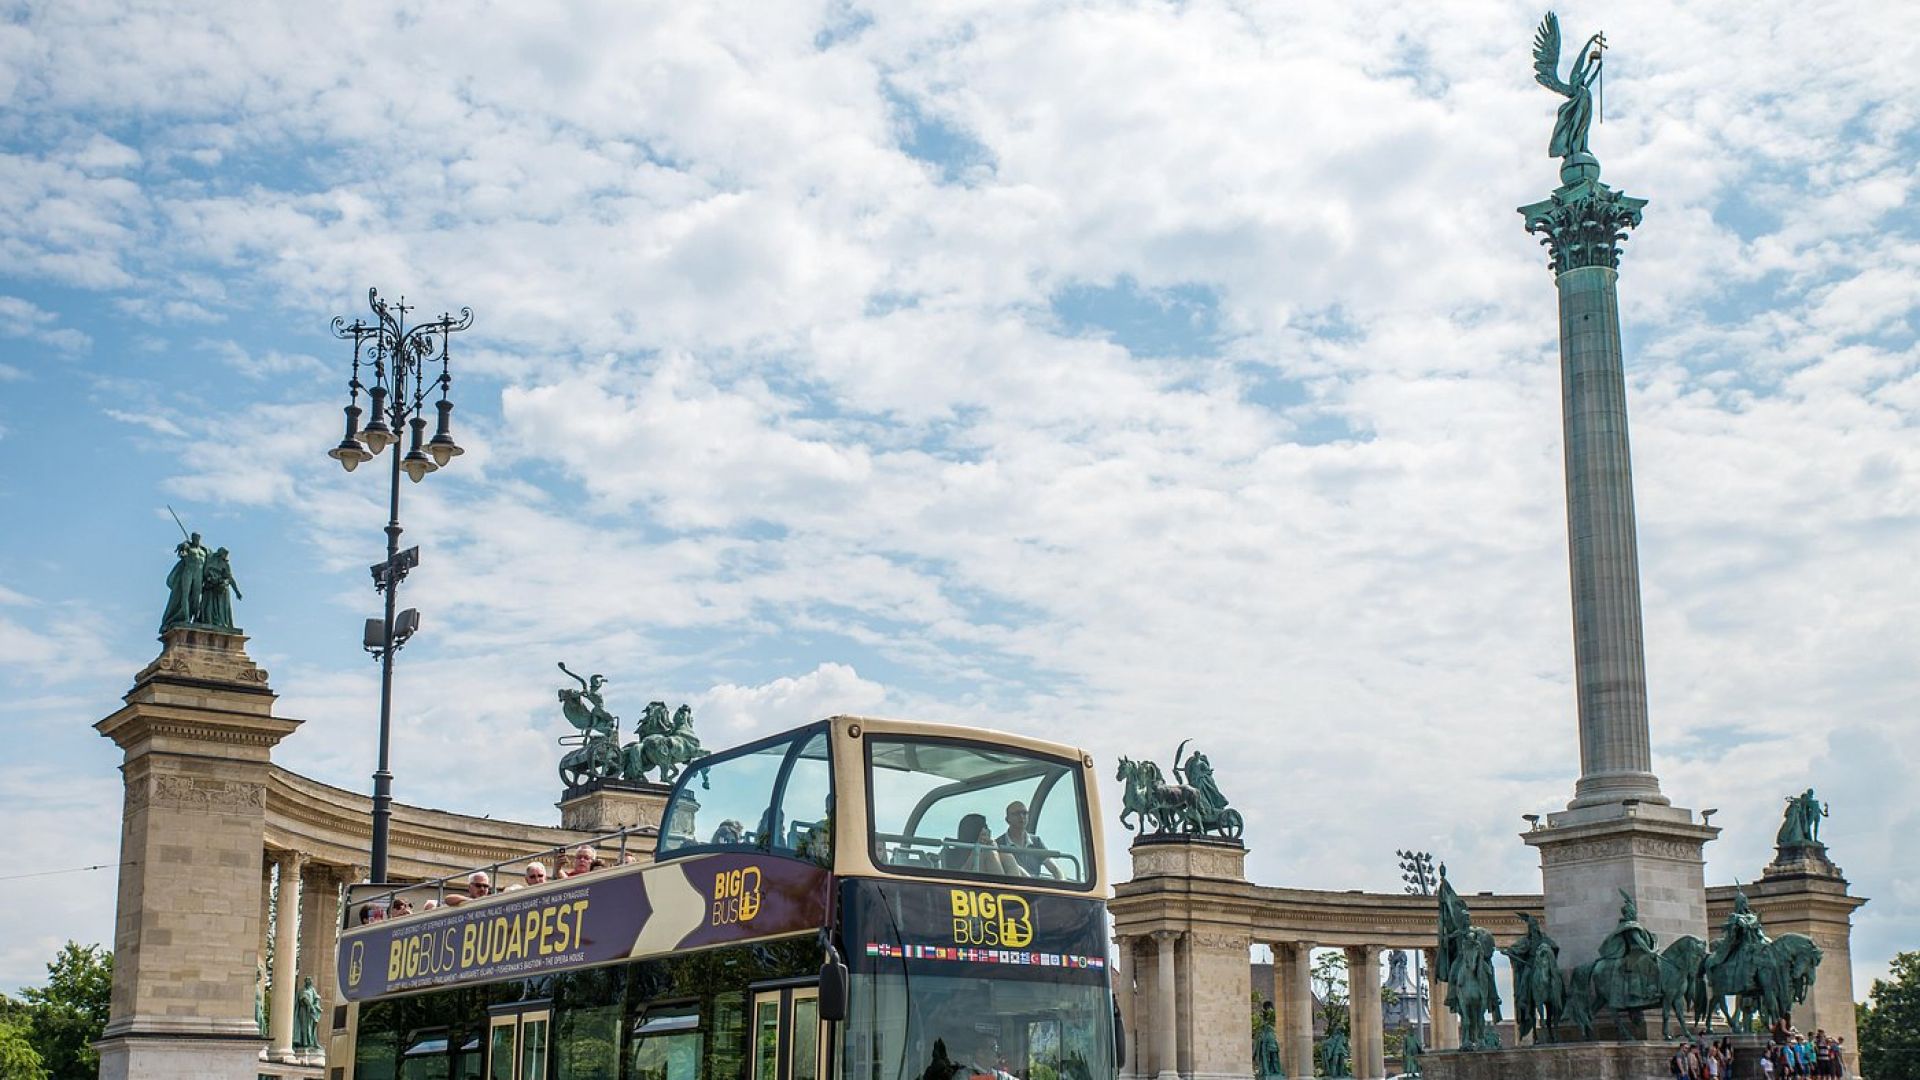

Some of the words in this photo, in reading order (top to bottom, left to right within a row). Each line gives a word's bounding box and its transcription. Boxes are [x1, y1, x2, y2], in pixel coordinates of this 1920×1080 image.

[715, 870, 740, 899] BIG
[487, 906, 502, 916] PALACE
[713, 898, 738, 926] BUS
[951, 889, 996, 919] BIG
[461, 900, 589, 969] BUDAPEST
[953, 918, 999, 945] BUS
[523, 958, 541, 969] BASTION
[545, 957, 553, 966] THE
[553, 954, 568, 965] OPERA
[568, 952, 584, 962] HOUSE
